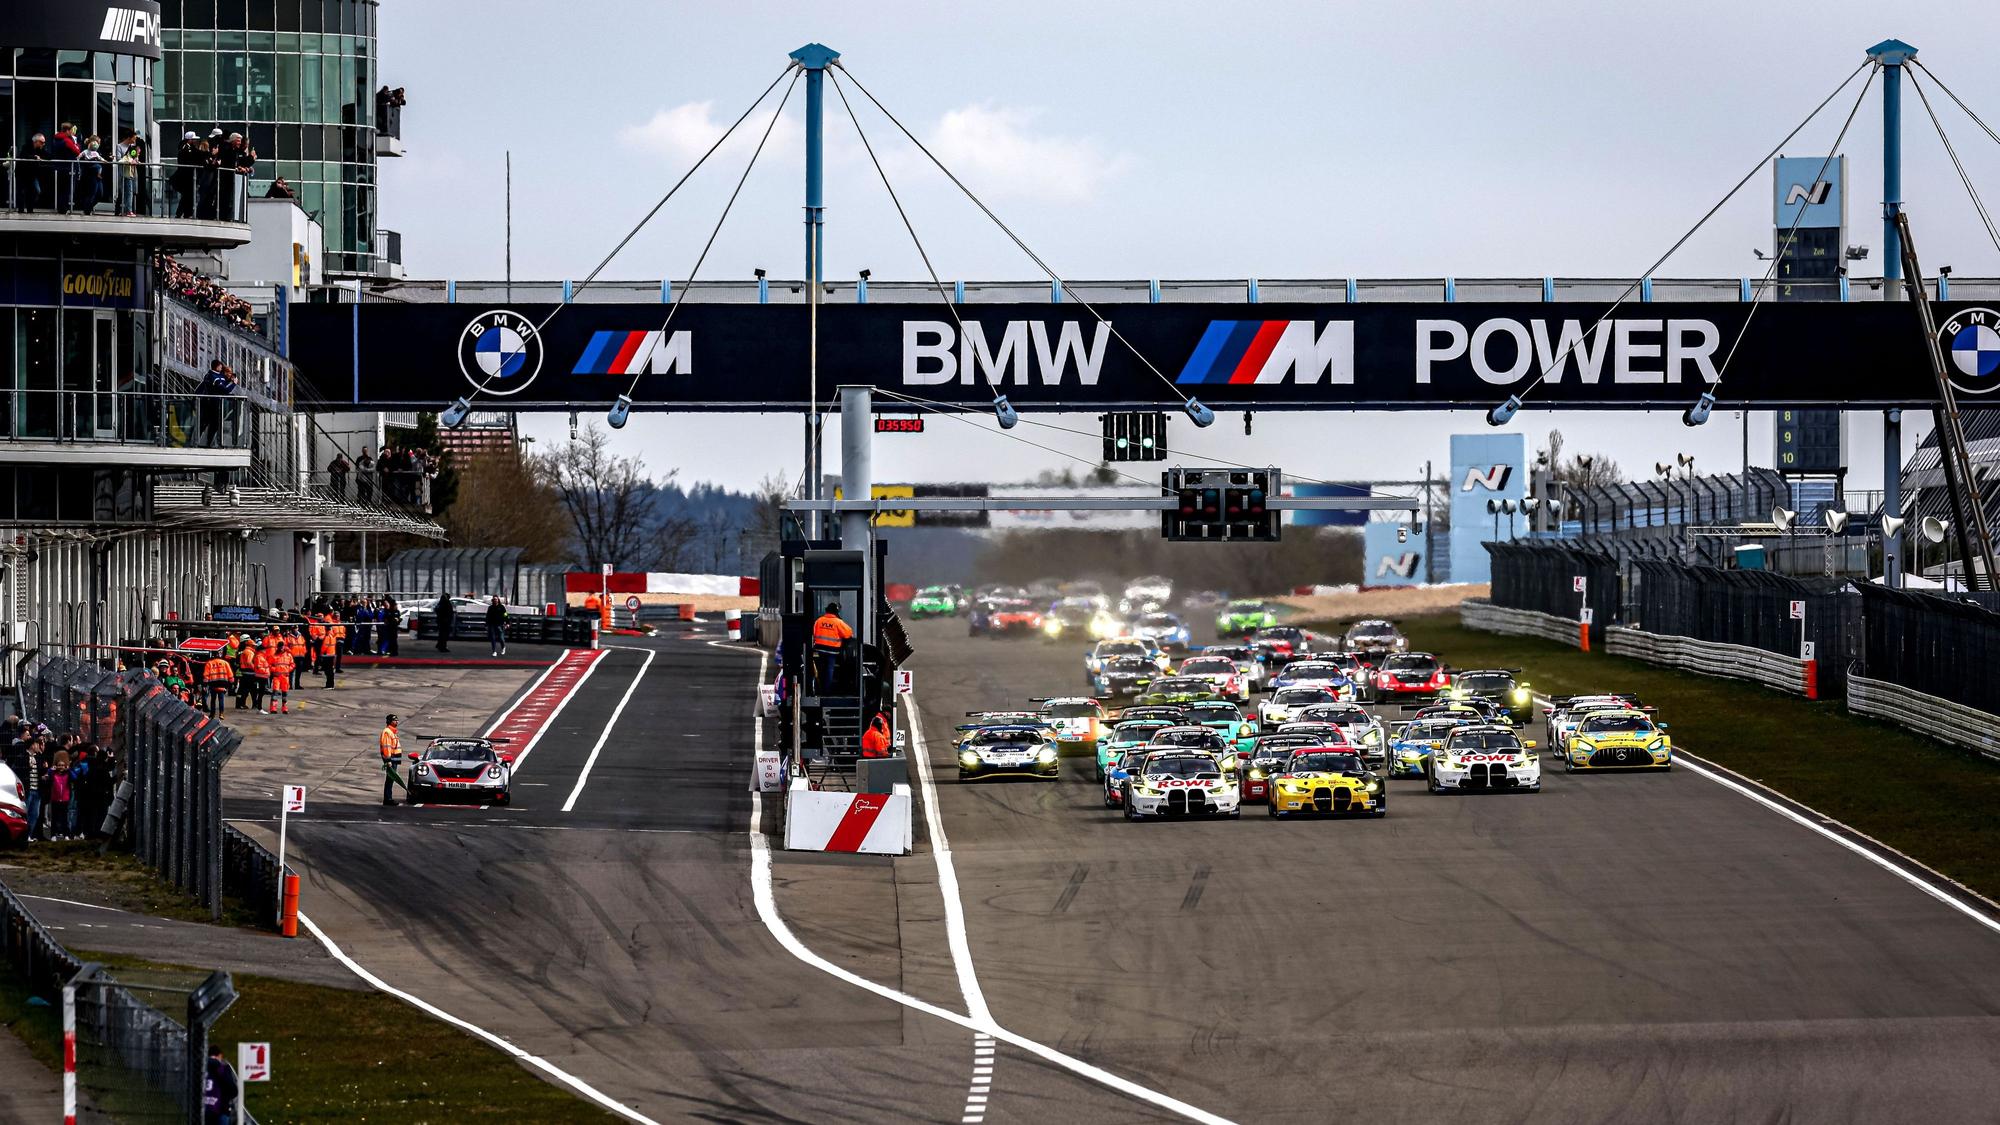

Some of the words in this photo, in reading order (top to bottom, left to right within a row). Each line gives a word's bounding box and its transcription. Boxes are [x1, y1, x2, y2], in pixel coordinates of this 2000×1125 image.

[1785, 264, 1790, 274] 1
[64, 273, 131, 297] GOODYEAR
[1785, 284, 1791, 296] 2
[470, 314, 532, 338] BMW
[903, 320, 1113, 385] BMW
[1416, 317, 1723, 385] POWER
[1784, 411, 1791, 421] 8
[1784, 431, 1791, 442] 9
[1782, 452, 1794, 463] 10
[1805, 644, 1810, 655] 2
[896, 732, 905, 741] 2a
[1460, 754, 1517, 763] ROWE
[1157, 779, 1215, 789] ROWE
